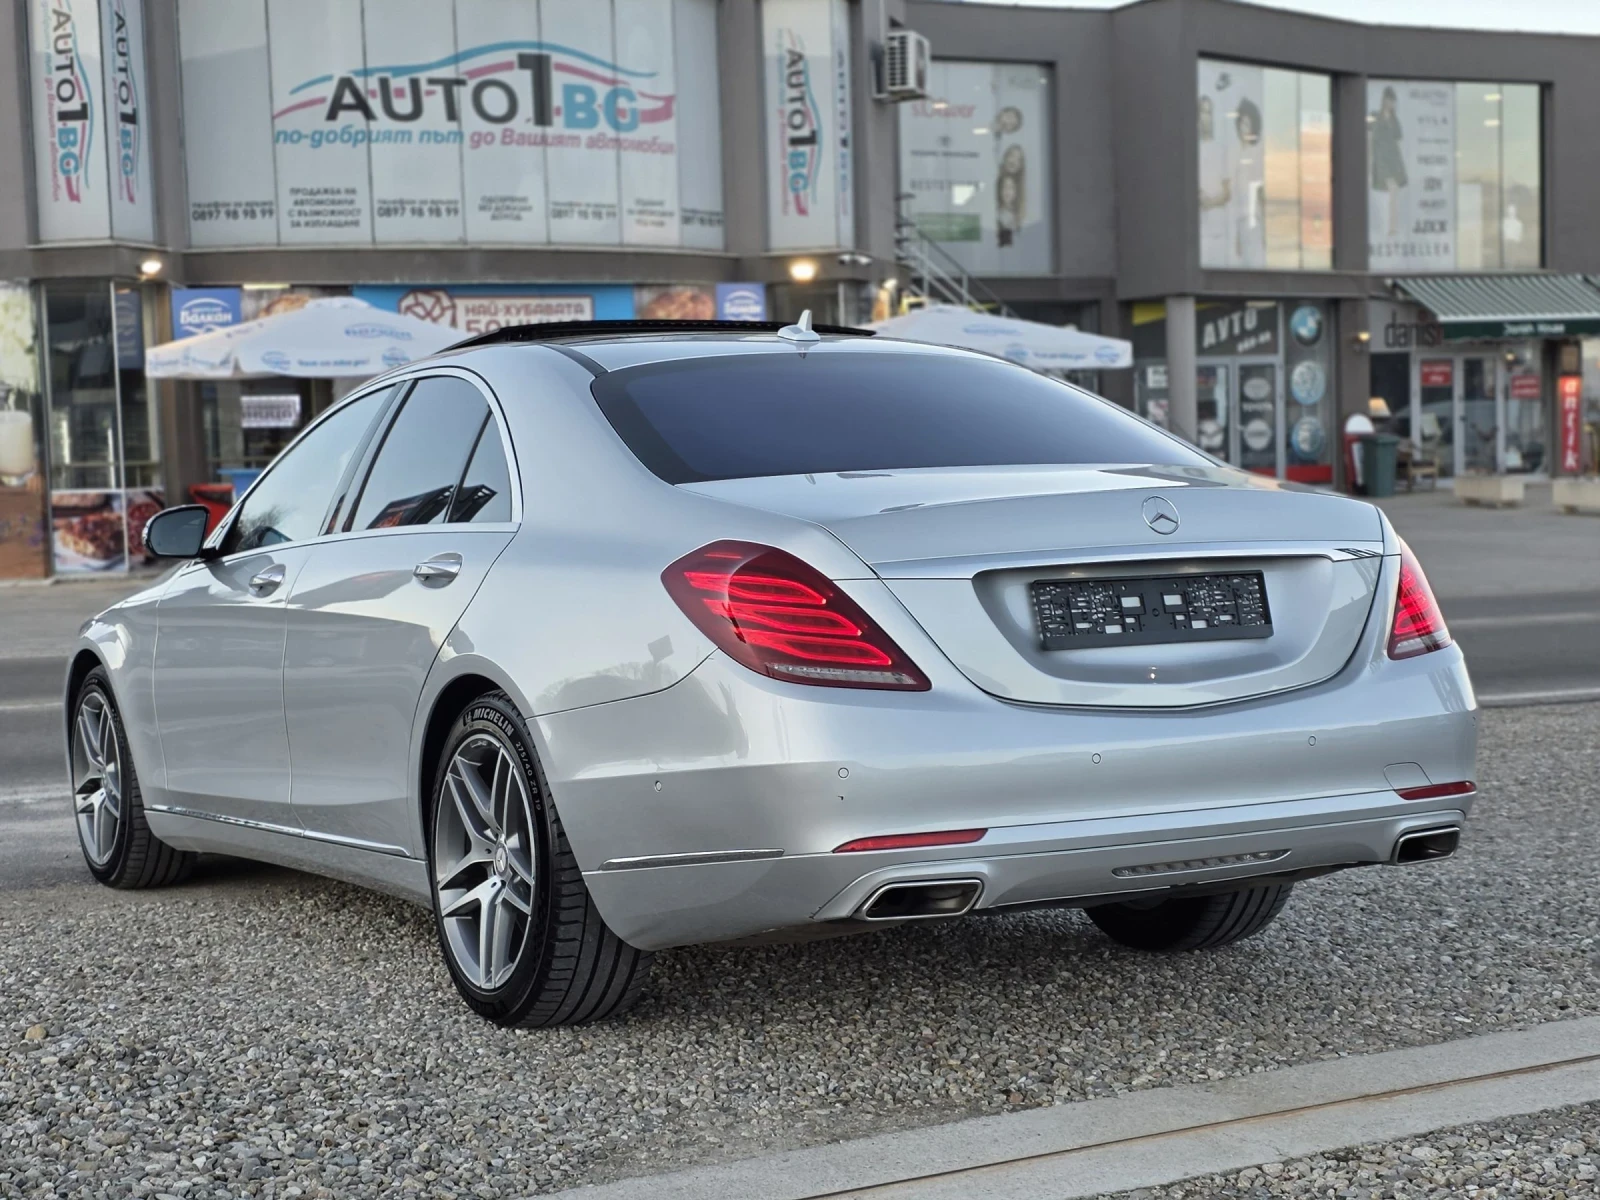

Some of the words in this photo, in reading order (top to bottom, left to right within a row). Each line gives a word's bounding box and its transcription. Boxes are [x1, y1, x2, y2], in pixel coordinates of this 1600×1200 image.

[419, 129, 464, 144] път
[470, 130, 495, 149] до
[473, 707, 514, 737] MICHELIN
[515, 741, 533, 776] 275/40
